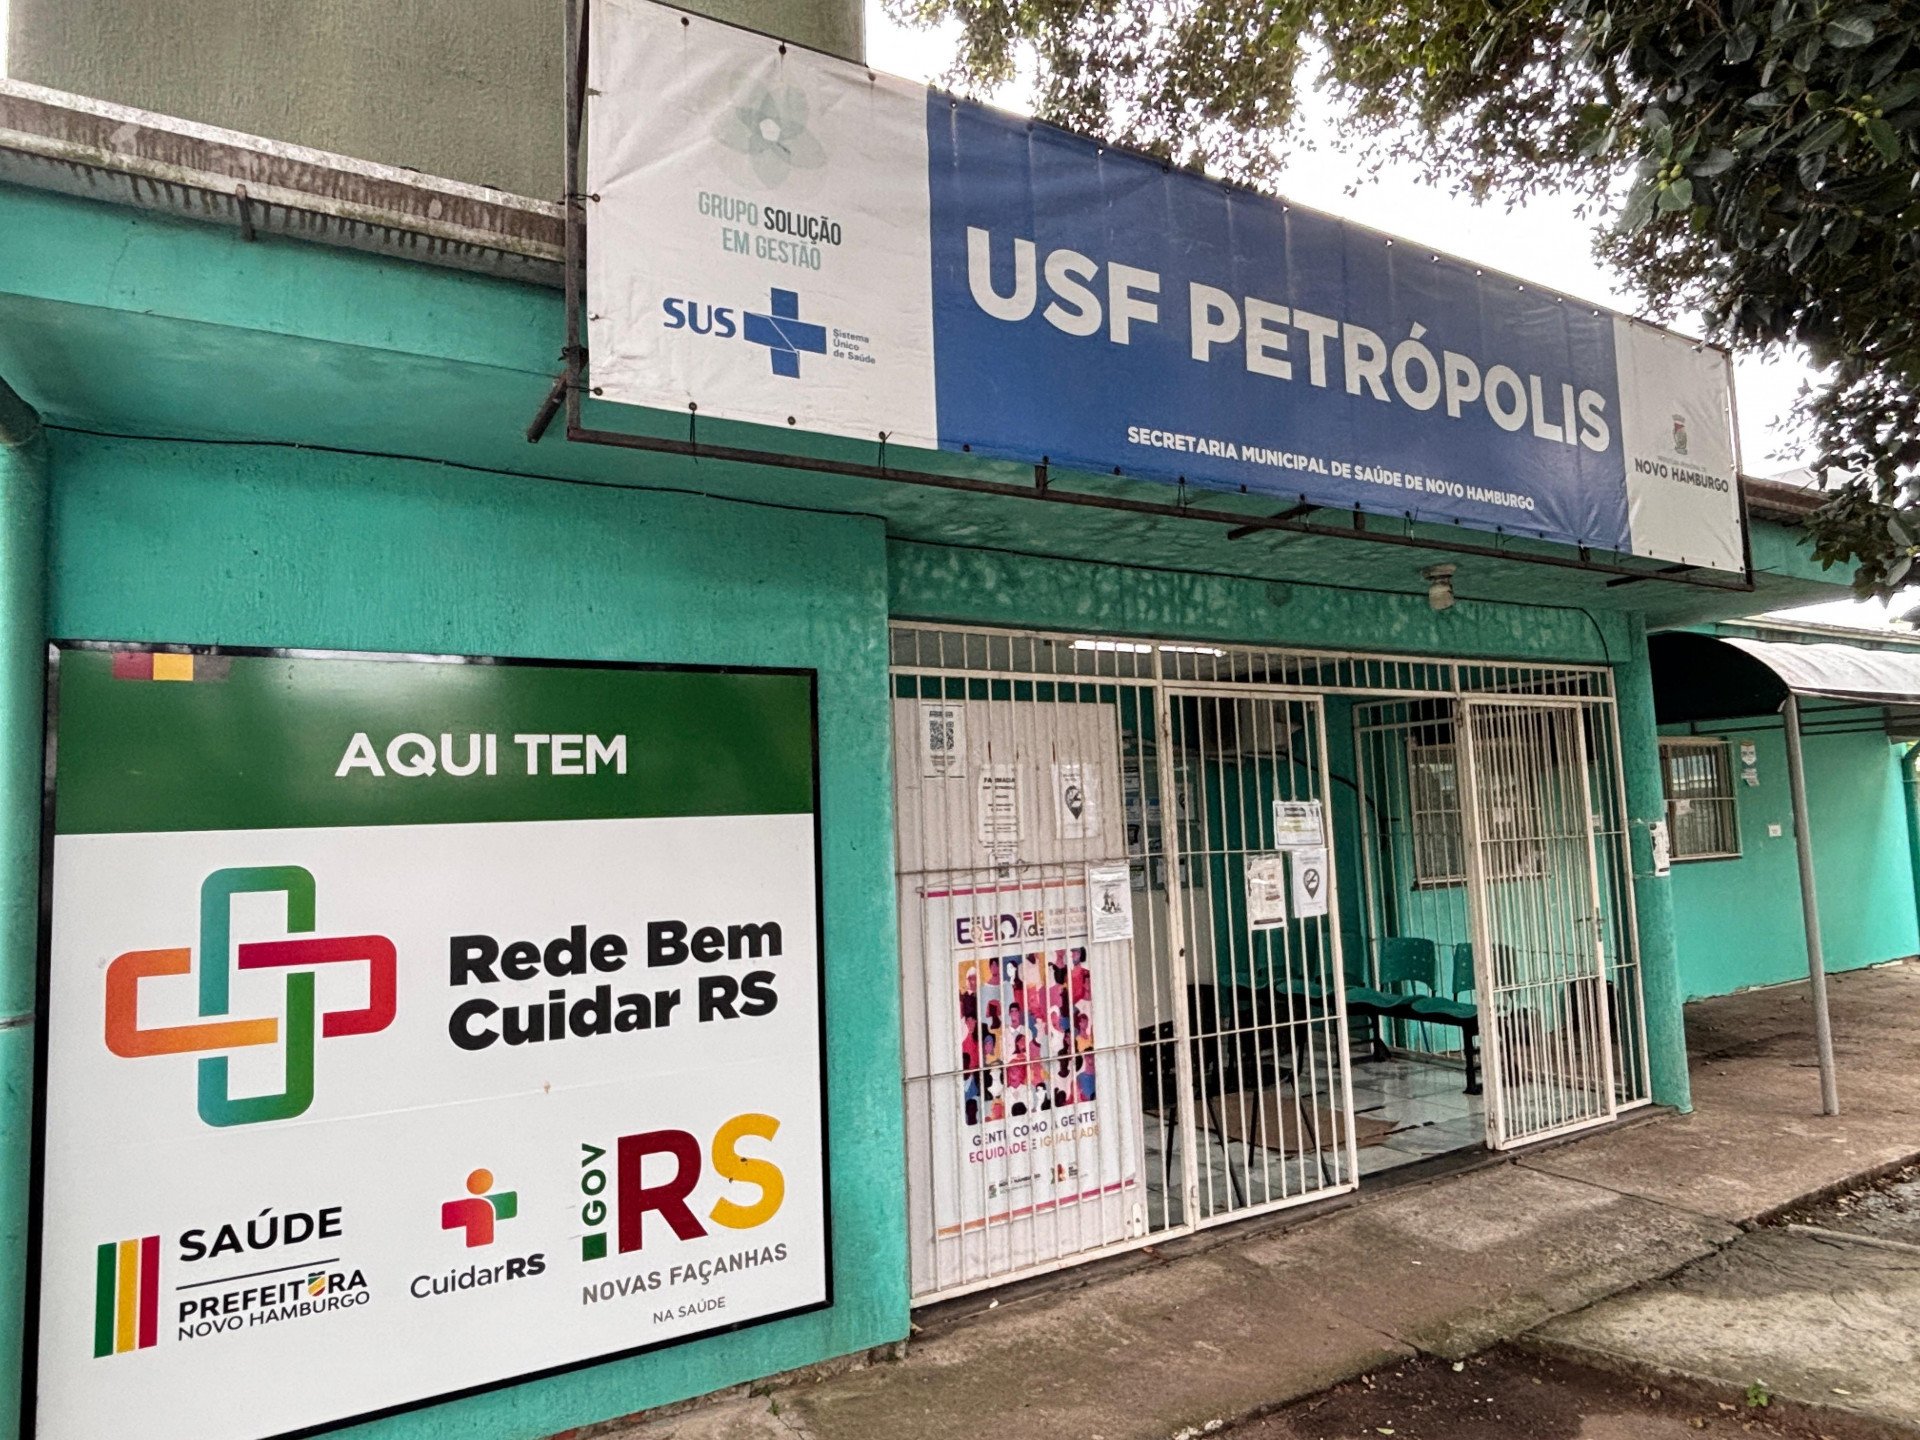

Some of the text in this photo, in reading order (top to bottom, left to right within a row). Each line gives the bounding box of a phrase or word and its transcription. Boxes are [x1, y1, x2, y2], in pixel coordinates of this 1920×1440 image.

[698, 191, 842, 246] GRUPO SOLUÇÃO
[722, 227, 821, 270] EM GESTÃO
[662, 297, 736, 338] SUS
[833, 328, 869, 343] Sistema
[967, 226, 1610, 452] USF PETRÓPOLIS
[833, 349, 876, 364] de Saúde
[1128, 426, 1535, 511] SECRETARIA MUNICIPAL DE SAÚDE DE NOVO HAMBURGO
[1635, 458, 1668, 478] NOVO
[1671, 467, 1729, 493] HAMBURGO
[334, 732, 627, 777] AQUI TEM
[449, 919, 783, 987] Rede Bem
[448, 970, 778, 1051] Cuidar RS
[1061, 1111, 1096, 1127] GENTE
[969, 1141, 1028, 1163] EQUIDADE
[581, 1142, 607, 1227] GOV
[617, 1113, 785, 1254] RS
[179, 1206, 342, 1262] SAÚDE
[410, 1253, 546, 1299] CuidarRS
[582, 1243, 788, 1305] NOVAS FAÇANHAS
[178, 1290, 370, 1341] NOVO HAMBURGO
[653, 1296, 726, 1324] NA SAÚDE
